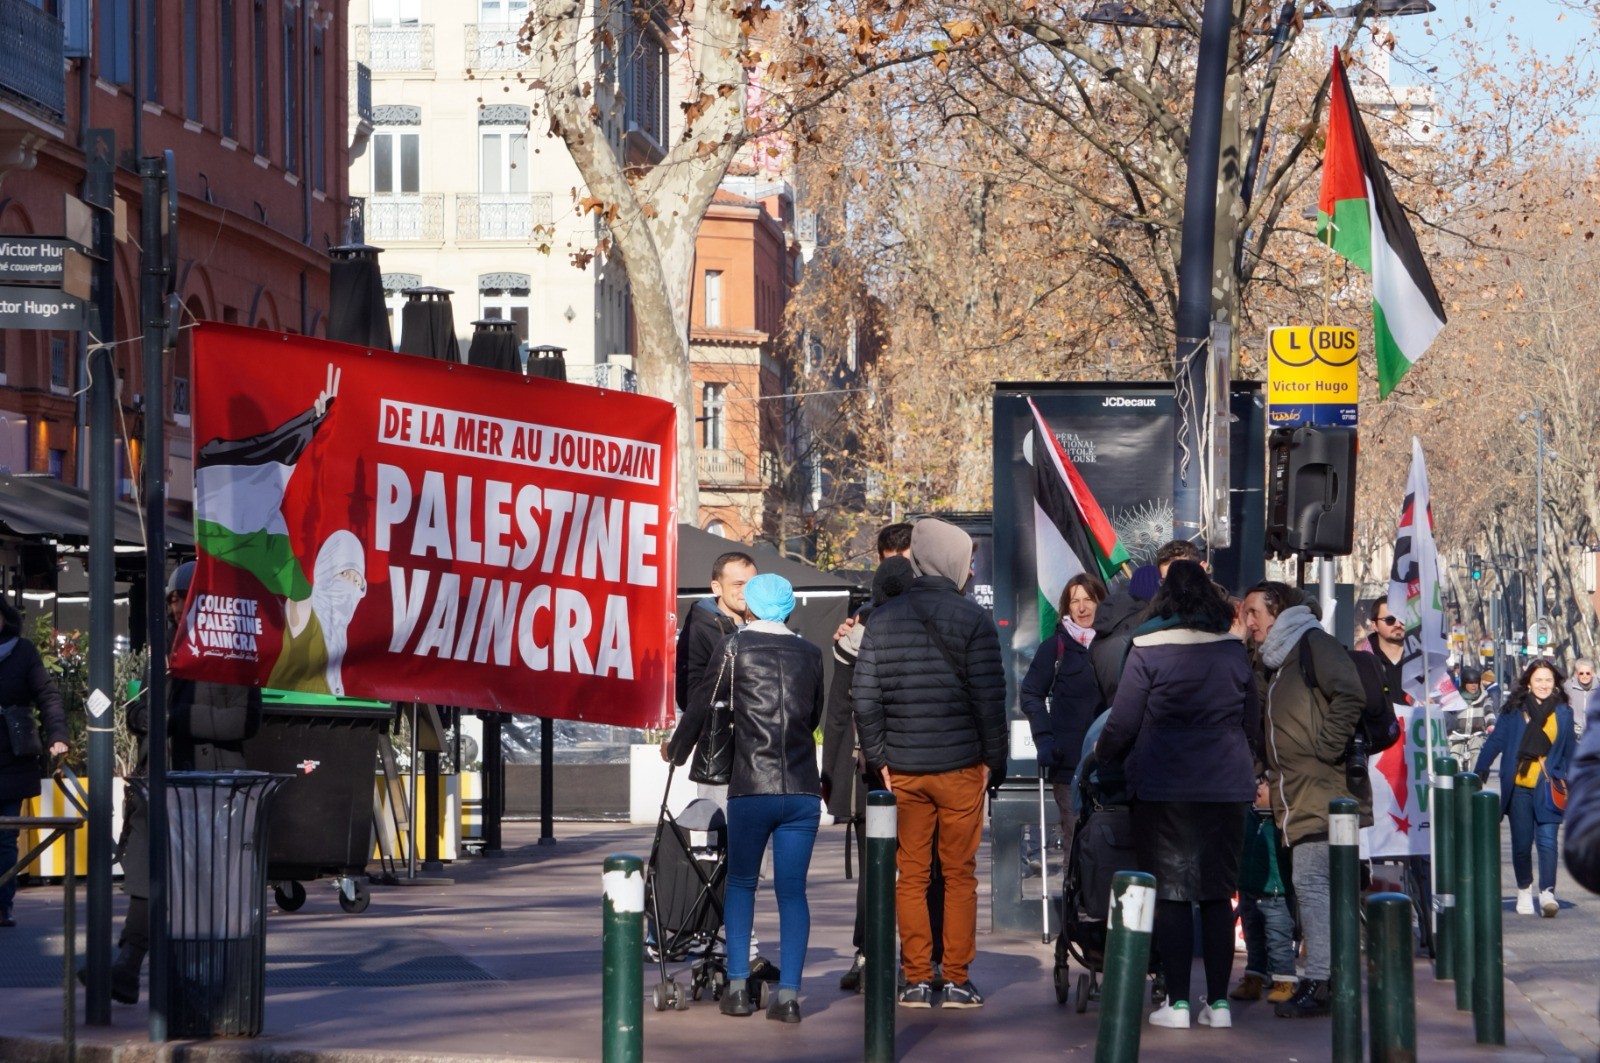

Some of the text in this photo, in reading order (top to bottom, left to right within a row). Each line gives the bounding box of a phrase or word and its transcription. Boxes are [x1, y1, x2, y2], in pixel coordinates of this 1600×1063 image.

[24, 301, 59, 317] Hugo
[1290, 331, 1355, 350] L BUS
[1273, 380, 1348, 393] Victor Hugo
[1102, 397, 1156, 407] JCDecaux
[383, 405, 656, 481] DE LA MER AU JOURDAIN
[1055, 433, 1079, 441] PÉRA
[375, 463, 660, 588] PALESTINE
[197, 594, 258, 616] COLLECTIF
[197, 613, 263, 635] PALESTINE
[388, 565, 635, 681] VAINCRA
[198, 630, 258, 652] VAINCRA
